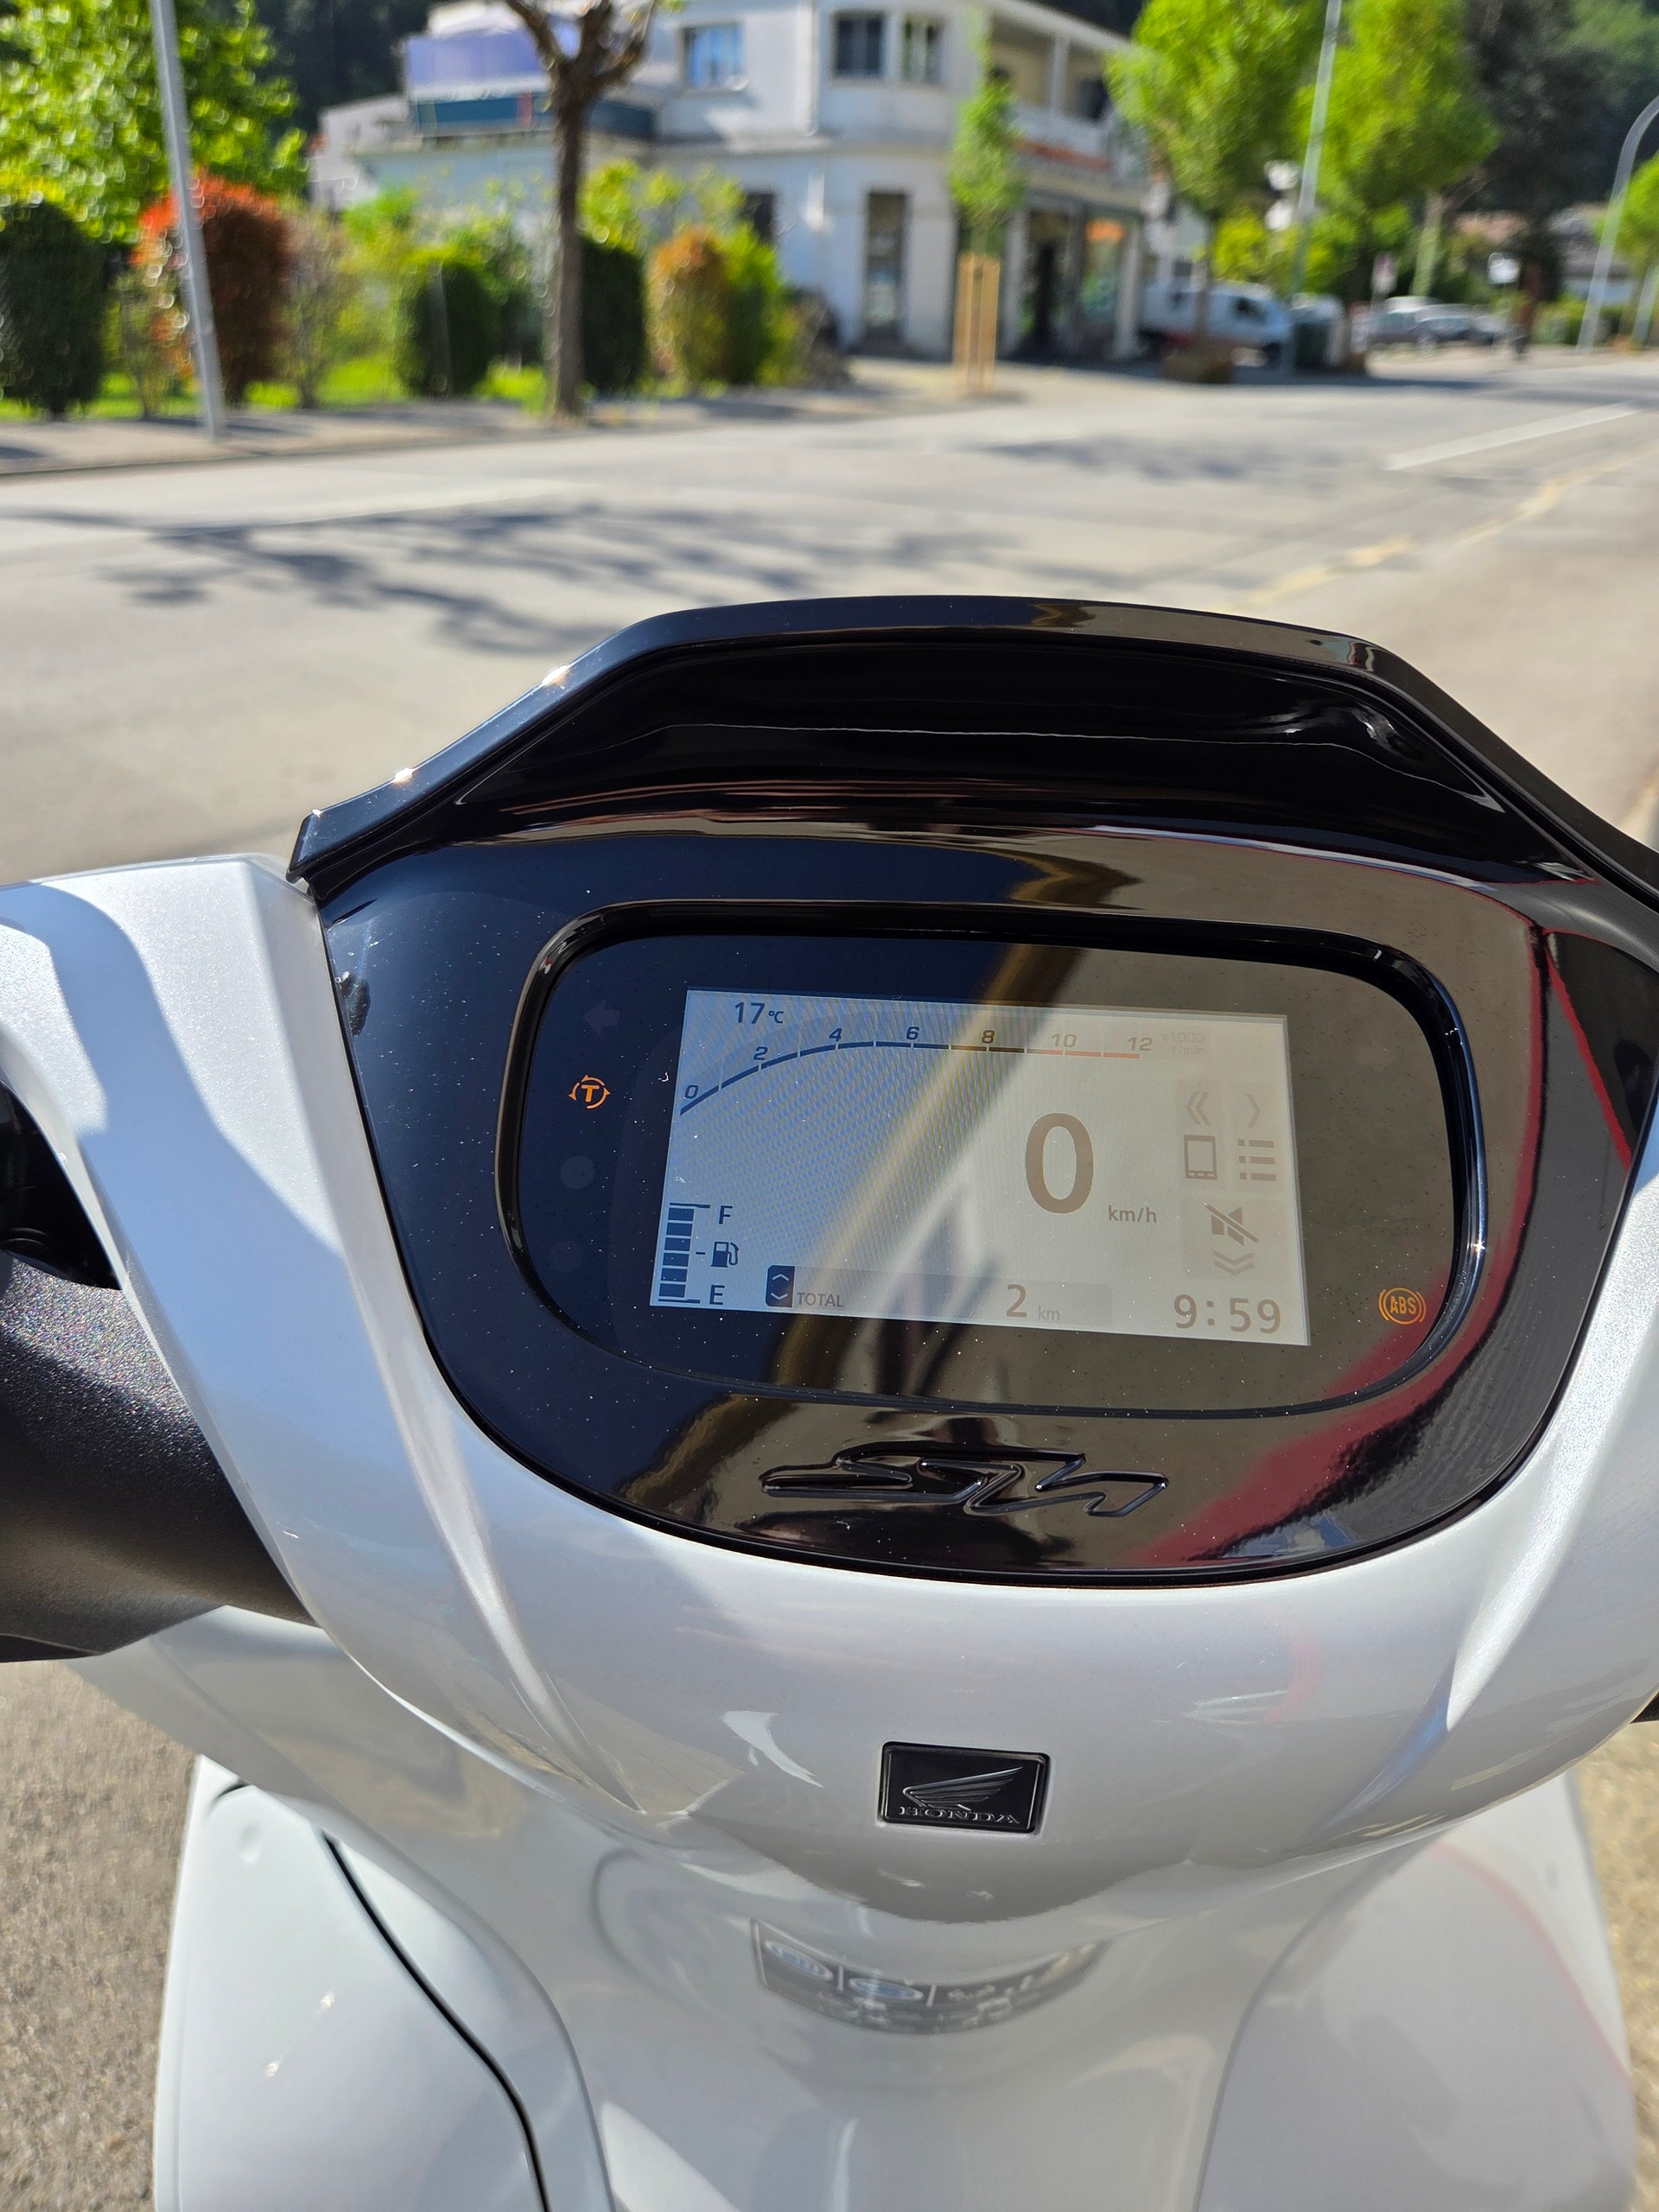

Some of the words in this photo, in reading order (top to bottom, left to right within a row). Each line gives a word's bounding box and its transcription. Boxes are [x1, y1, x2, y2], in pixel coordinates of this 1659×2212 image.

[683, 1084, 700, 1100] 0
[752, 1046, 769, 1061] 2
[828, 1027, 843, 1042] 4
[906, 1026, 920, 1040] 6
[980, 1029, 996, 1045] 8
[1050, 1033, 1077, 1048] 10
[1127, 1036, 1154, 1052] 12
[1024, 1112, 1095, 1215] 0
[718, 1205, 734, 1225] F
[1107, 1205, 1158, 1224] km/h
[709, 1284, 726, 1306] E
[797, 1292, 844, 1308] TOTAL
[1005, 1283, 1028, 1319] 2
[1038, 1305, 1061, 1321] km
[1389, 1295, 1418, 1315] ABS
[1173, 1293, 1282, 1335] 9:59
[899, 1805, 1020, 1825] HONDA
